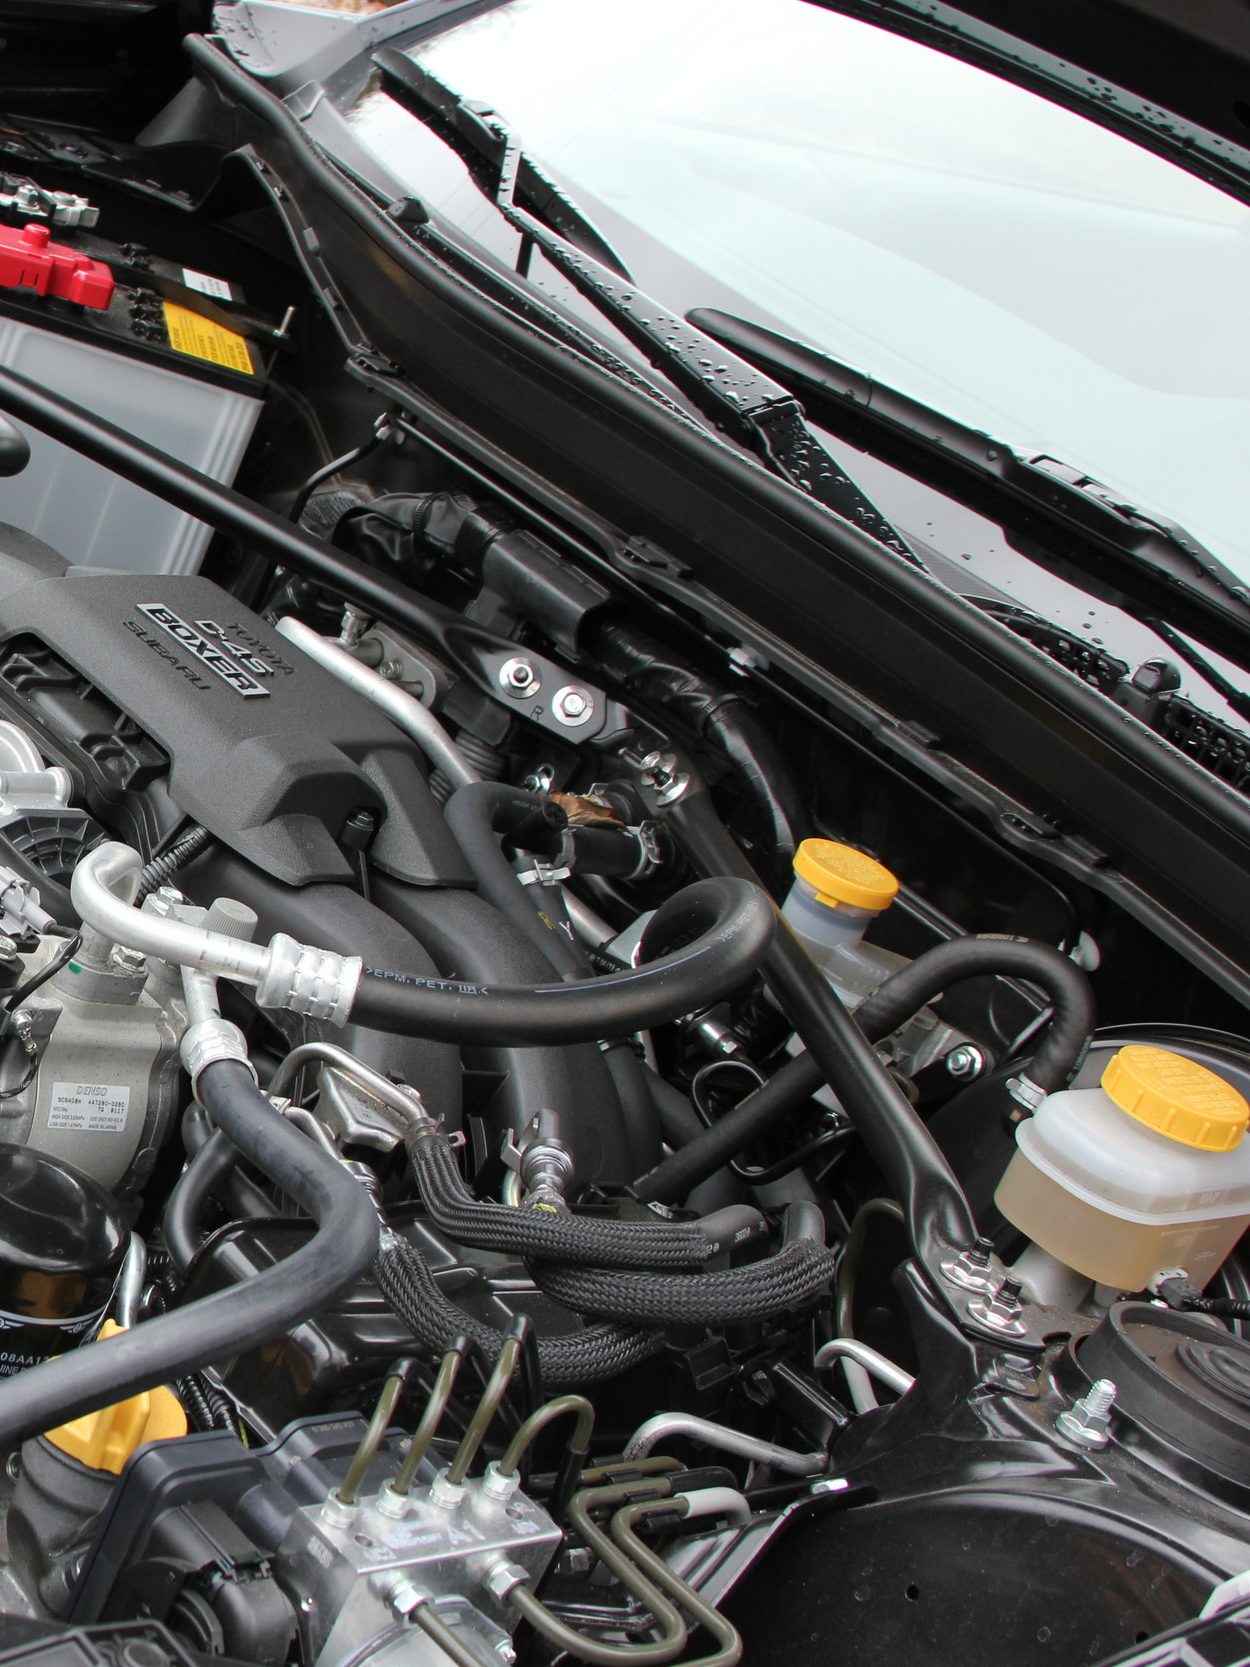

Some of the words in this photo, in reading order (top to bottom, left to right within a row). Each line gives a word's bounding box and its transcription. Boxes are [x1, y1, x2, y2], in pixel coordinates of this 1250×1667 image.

[122, 620, 212, 691] SUBARU
[142, 605, 262, 692] BOXER
[227, 622, 297, 676] TOYOTA
[75, 1085, 108, 1096] DENSO
